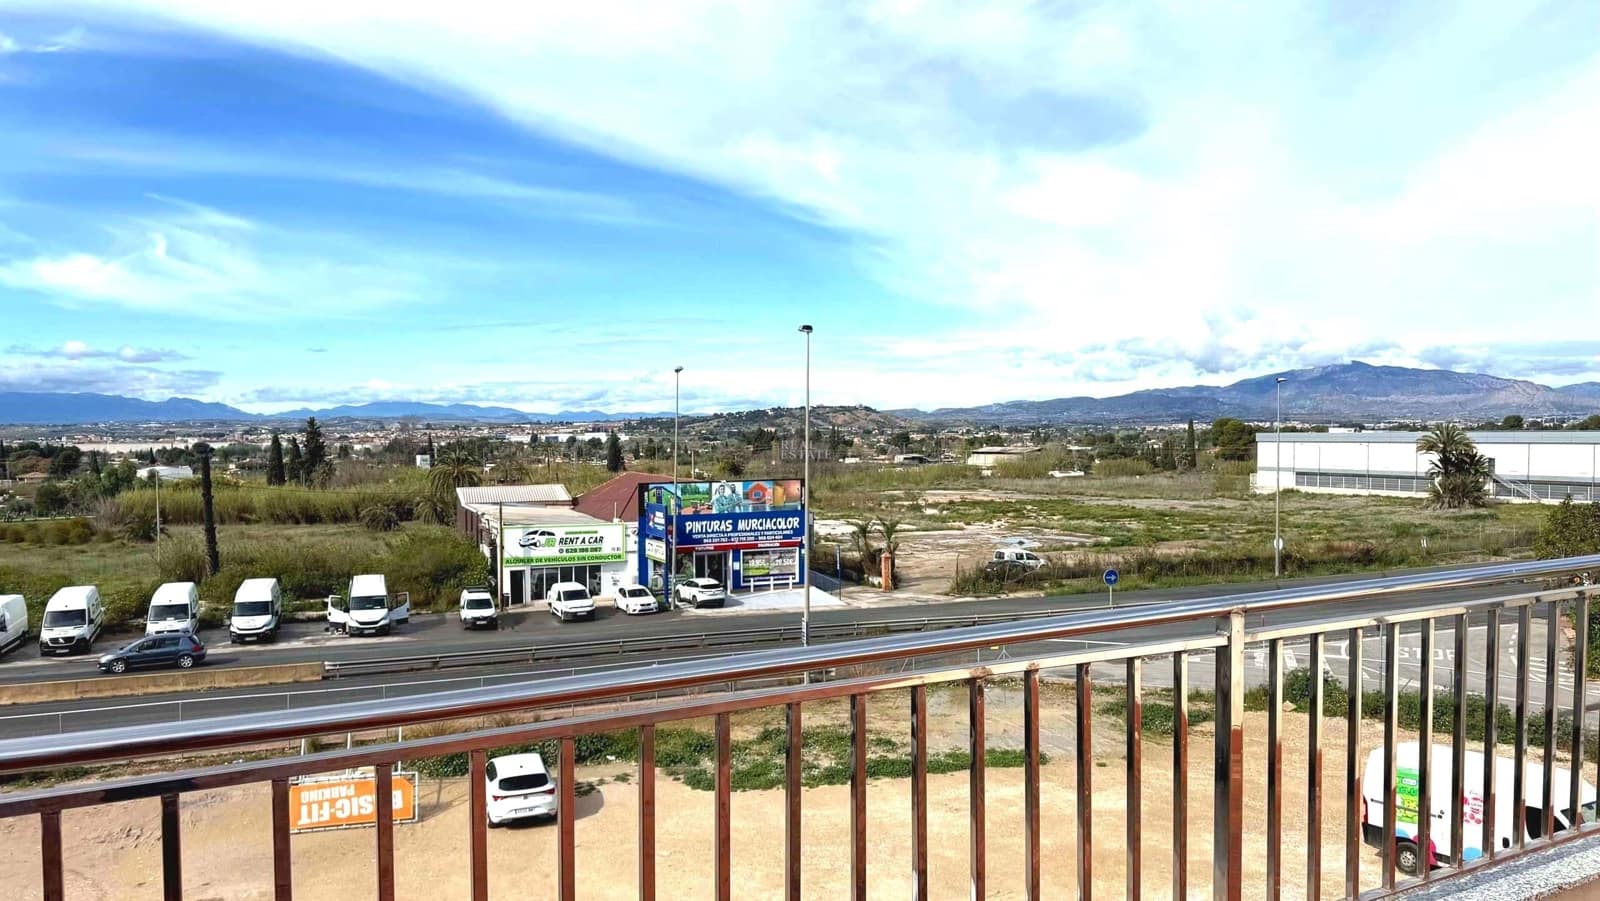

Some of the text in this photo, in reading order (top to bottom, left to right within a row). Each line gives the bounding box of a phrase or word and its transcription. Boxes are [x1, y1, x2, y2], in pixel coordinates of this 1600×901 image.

[685, 517, 800, 534] PINTURAS MURCIACOLOR
[558, 537, 579, 546] RENT
[588, 536, 604, 544] CAR
[505, 557, 535, 565] ALQUILER
[587, 554, 622, 562] CONDUCTOR
[301, 784, 355, 803] PARKING
[297, 789, 404, 826] BSIC-FIT
